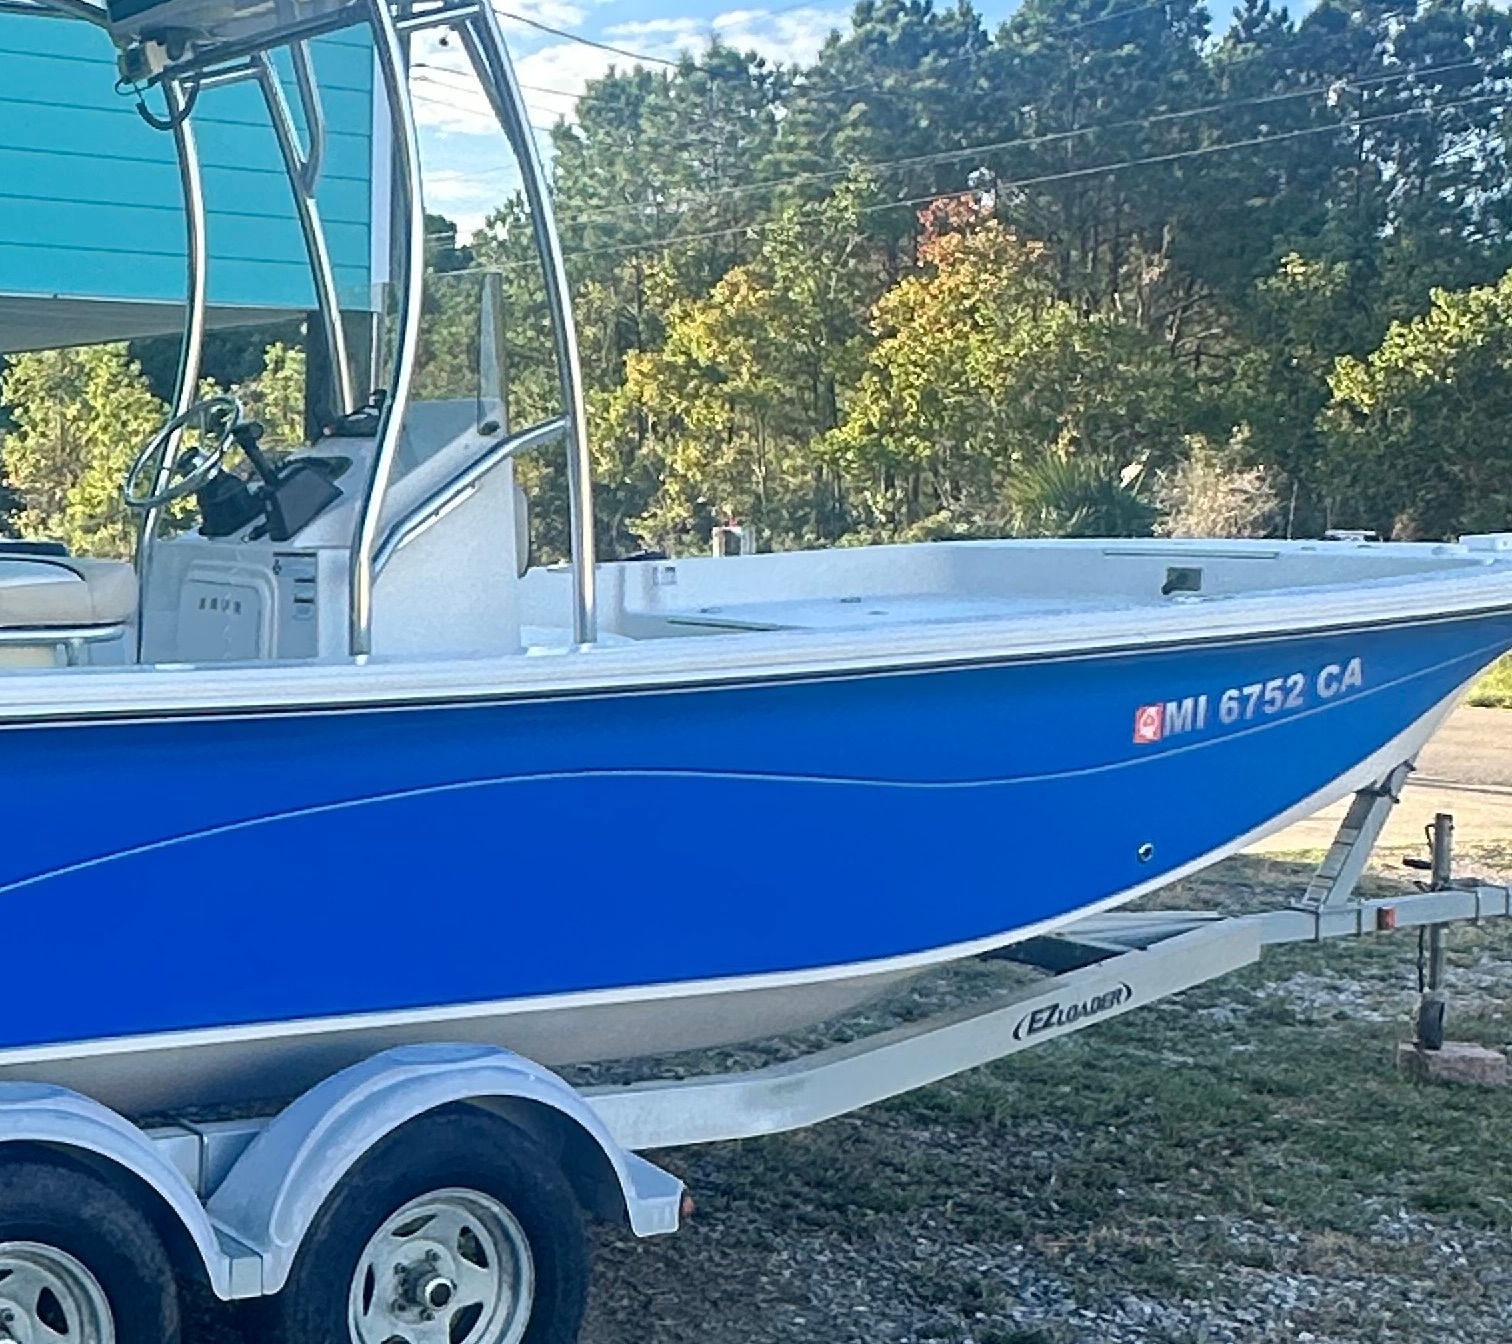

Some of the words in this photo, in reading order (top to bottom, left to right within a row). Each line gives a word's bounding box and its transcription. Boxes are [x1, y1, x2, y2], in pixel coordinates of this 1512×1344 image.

[1163, 694, 1208, 737] MI
[1219, 672, 1305, 724] 6752
[1316, 656, 1363, 699] CA
